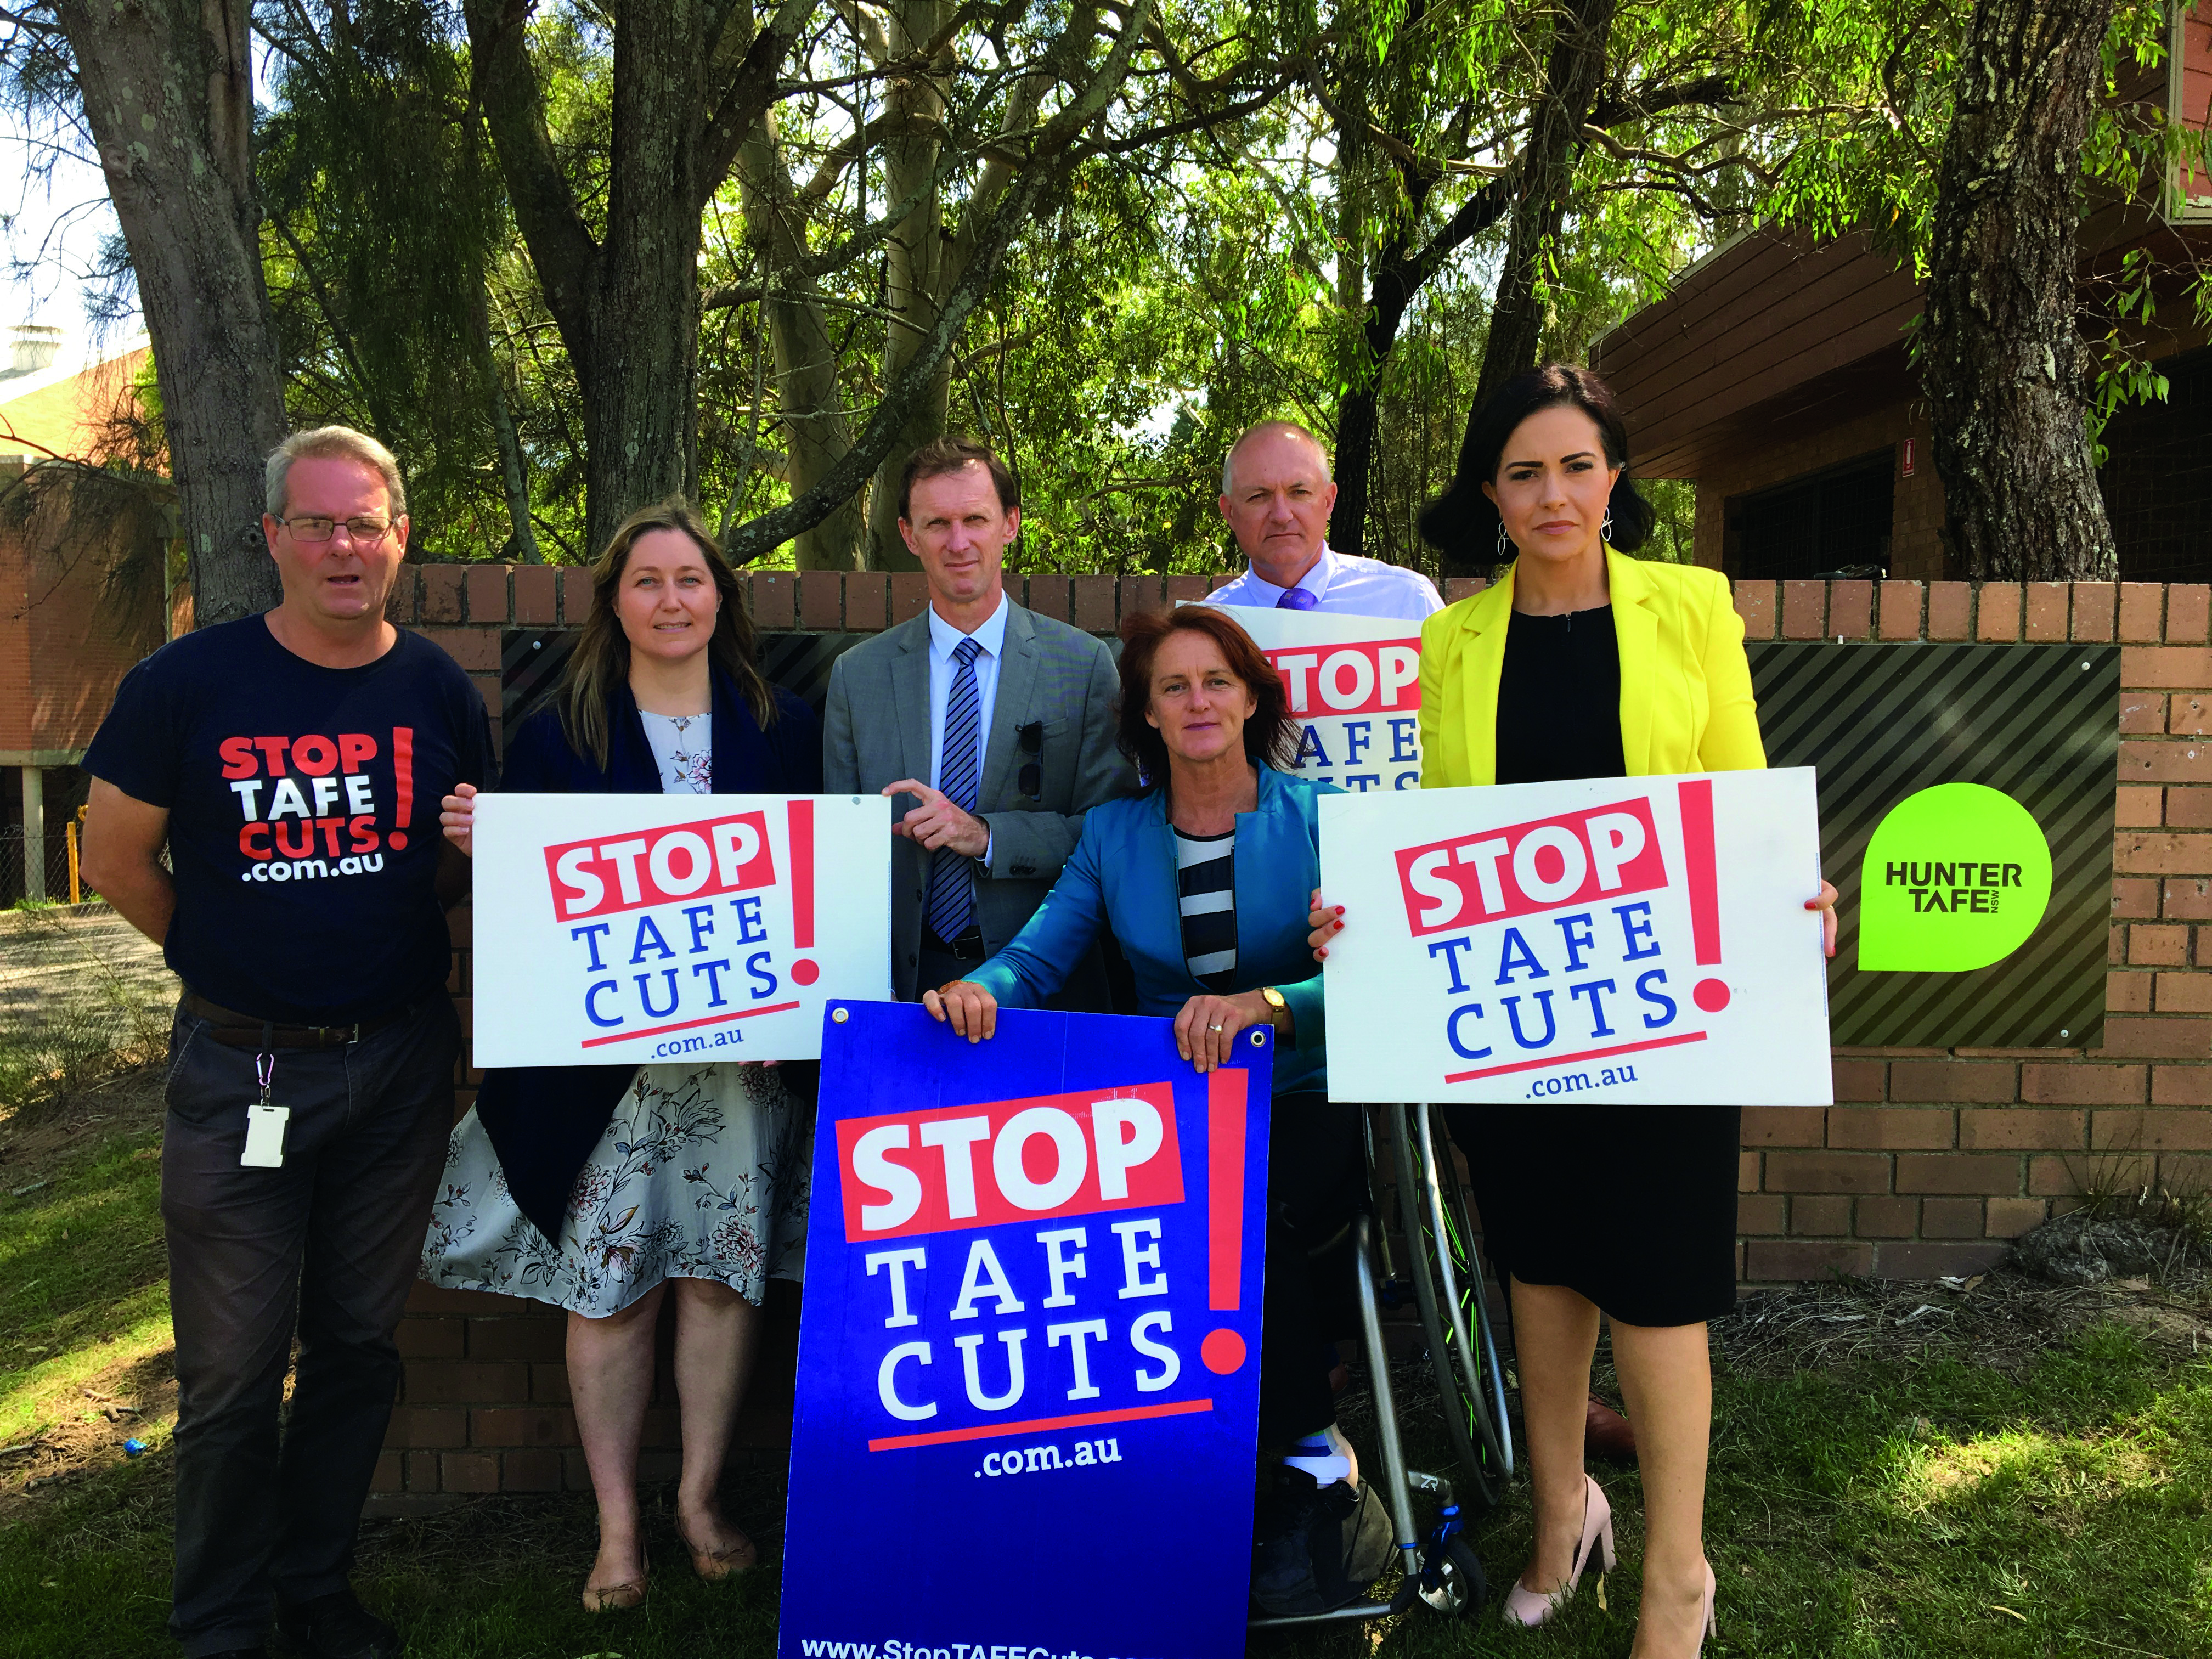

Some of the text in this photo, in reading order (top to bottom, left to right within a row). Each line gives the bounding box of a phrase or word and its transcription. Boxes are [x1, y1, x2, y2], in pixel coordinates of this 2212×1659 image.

[1266, 646, 1420, 712] TOP
[219, 734, 377, 780] STOP
[1290, 718, 1418, 769] AFE
[230, 775, 375, 821] TAFE
[239, 816, 379, 860] CUTS
[242, 853, 383, 882] .com.au
[556, 822, 760, 915] STOP
[1409, 812, 1646, 928] STOP
[1886, 862, 2022, 887] HUNTER
[1908, 889, 1990, 913] TAFE
[1991, 890, 1999, 913] NSW
[571, 896, 768, 973] TAFE
[1427, 901, 1662, 995] TAFE
[585, 951, 778, 1027] CUTS
[1447, 969, 1678, 1060] CUTS
[651, 1028, 744, 1059] .com.au
[1526, 1064, 1638, 1099] .com.au
[852, 1098, 1164, 1231] STOP
[865, 1218, 1169, 1329] TAFE
[878, 1311, 1181, 1421] CUTS
[974, 1438, 1122, 1479] .com.au
